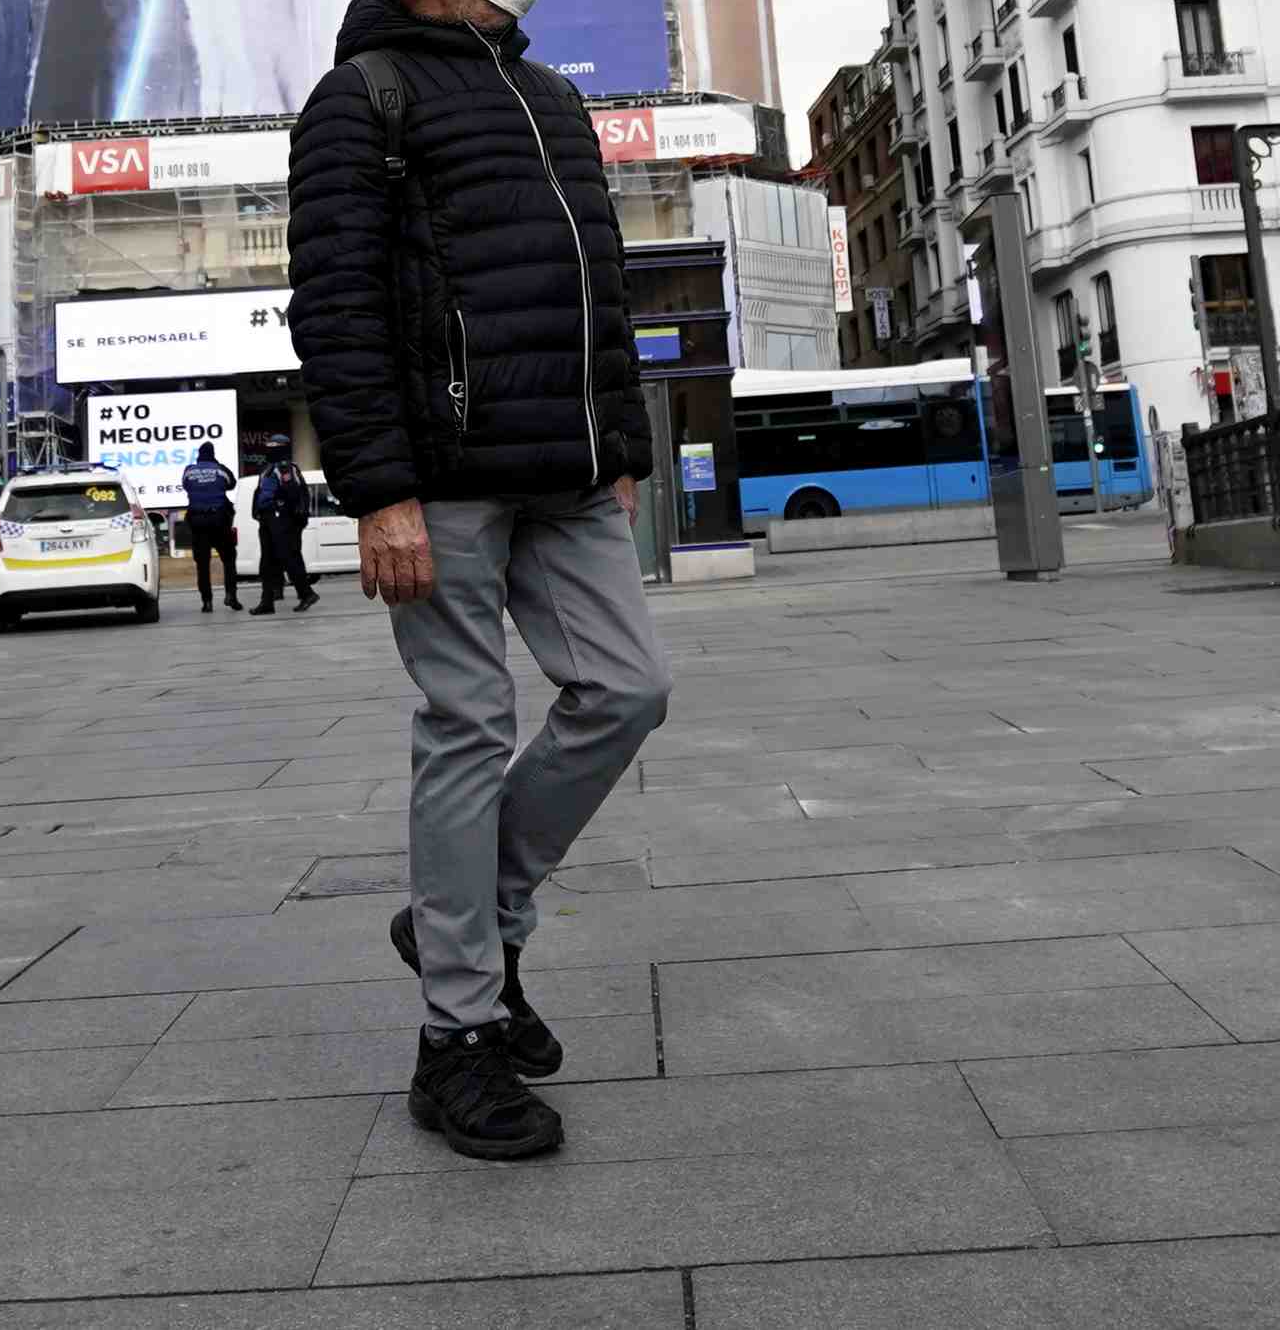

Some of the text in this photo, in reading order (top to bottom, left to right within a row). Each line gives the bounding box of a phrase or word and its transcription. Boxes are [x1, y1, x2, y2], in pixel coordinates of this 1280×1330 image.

[77, 148, 144, 175] VSA
[67, 331, 208, 348] SE RESPONSABLE
[100, 404, 150, 421] #YO
[99, 423, 223, 445] MEQUEDO
